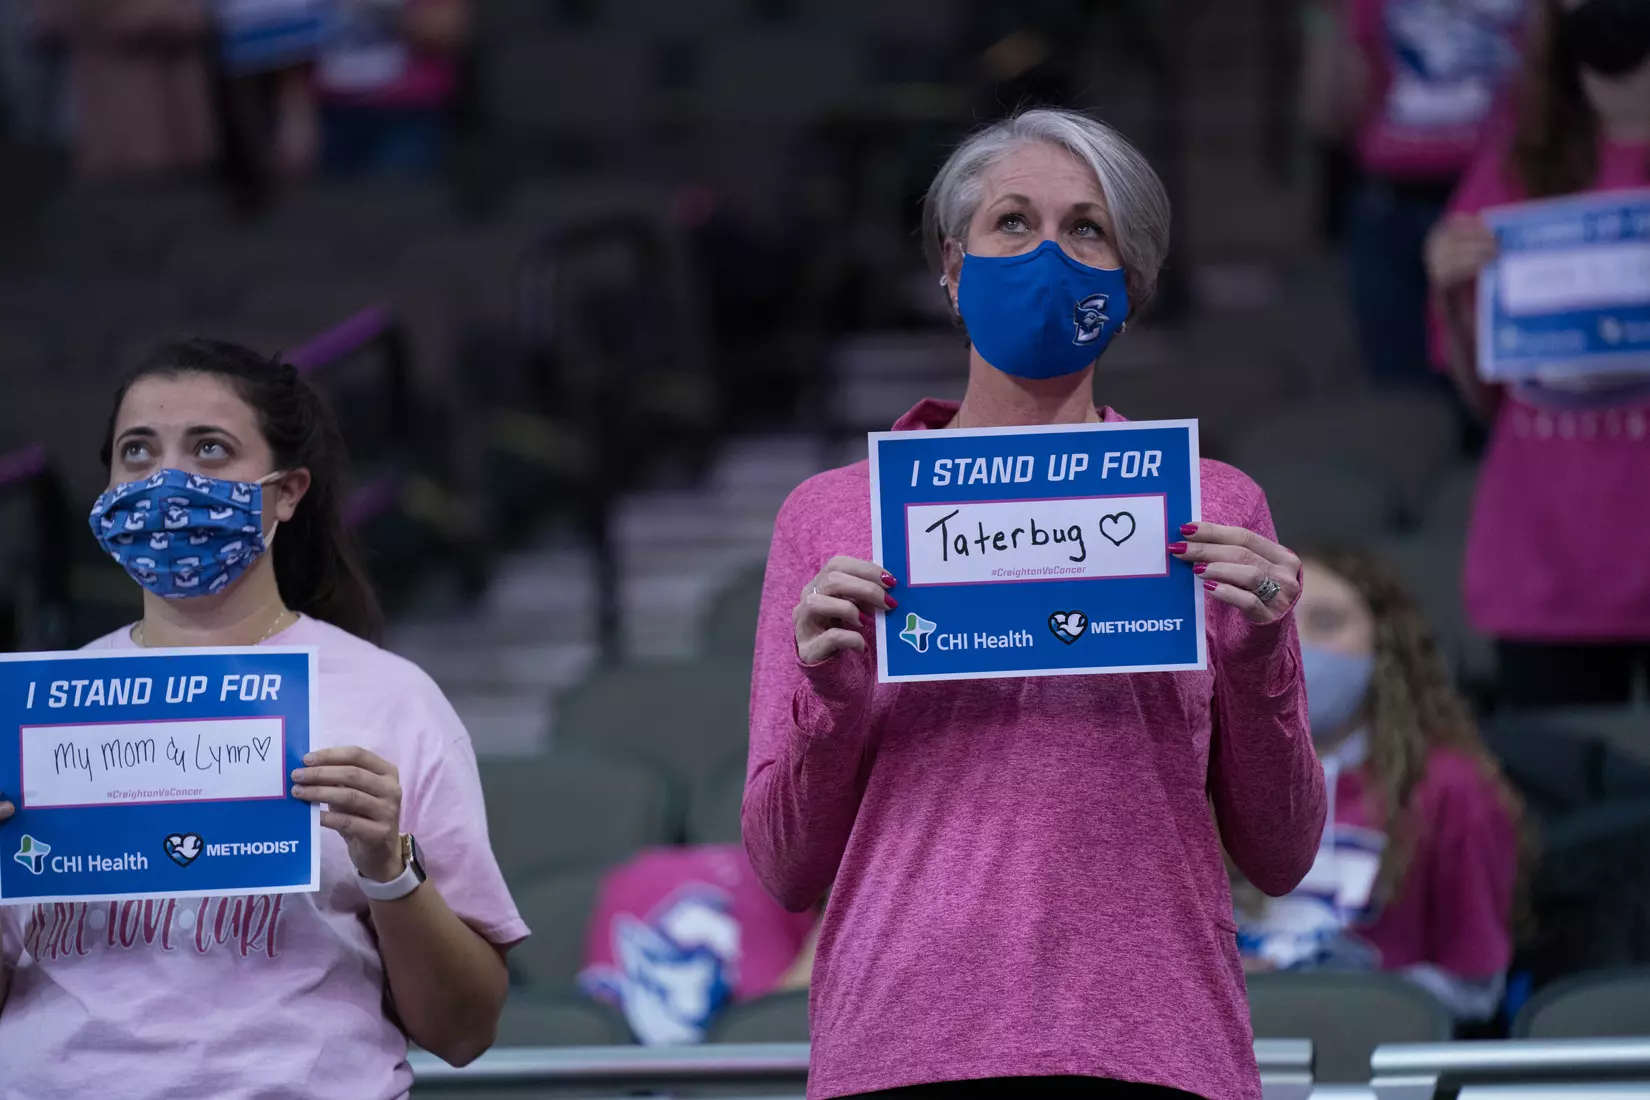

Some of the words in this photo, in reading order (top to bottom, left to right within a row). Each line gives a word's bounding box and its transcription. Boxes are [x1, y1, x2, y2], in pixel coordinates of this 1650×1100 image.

[910, 459, 920, 487] I
[932, 455, 1035, 487] STAND
[1047, 453, 1089, 482] UP
[1101, 450, 1163, 480] FOR
[925, 509, 1087, 562] Taterbug
[991, 565, 1087, 578] #CreightonVsCancer
[1090, 618, 1184, 635] METHODIST
[936, 633, 968, 651] CHI
[974, 630, 1034, 649] Health
[26, 681, 36, 709] I
[48, 677, 153, 709] STAND
[165, 675, 208, 704] UP
[219, 674, 282, 702] FOR
[195, 733, 251, 775] Lynn
[107, 787, 203, 800] #CreightonVsCancer
[206, 840, 299, 857] METHODIST
[51, 856, 82, 874] CHI
[88, 853, 149, 873] Health
